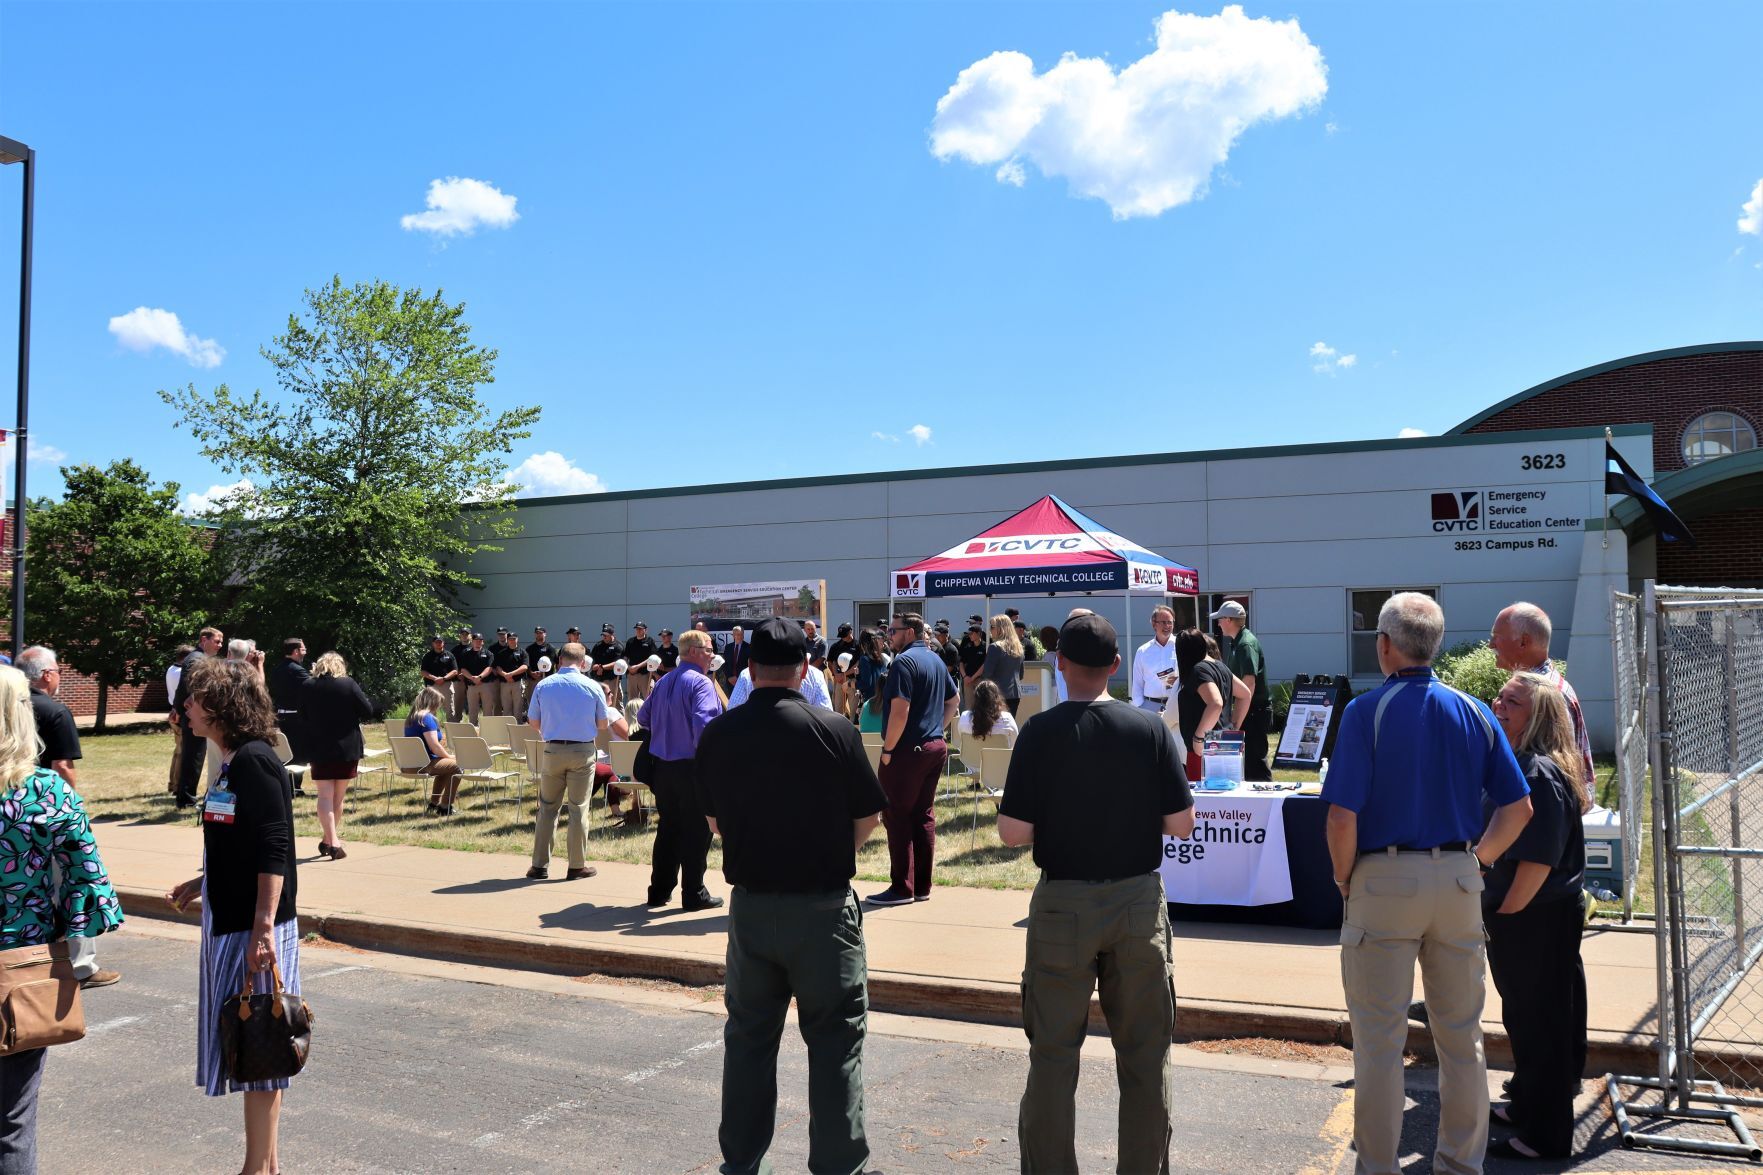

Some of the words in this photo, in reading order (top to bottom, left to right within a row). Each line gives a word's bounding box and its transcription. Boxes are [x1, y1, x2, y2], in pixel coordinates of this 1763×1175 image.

[1521, 453, 1566, 470] 3623
[1488, 490, 1546, 501] Emergency
[1488, 505, 1527, 515] Service
[1432, 519, 1479, 532] CVTC
[1489, 518, 1542, 530] Education
[1544, 517, 1581, 528] Center
[1000, 537, 1082, 552] CVTC
[1454, 540, 1482, 551] 3623
[1485, 538, 1534, 551] Campus
[1537, 537, 1558, 548] Rd.
[934, 576, 982, 588] CHIPPEWA
[983, 575, 1016, 586] VALLEY
[1018, 573, 1070, 585] TECHNICAL
[1072, 571, 1115, 583] COLLEGE
[1142, 569, 1163, 584] CVTC
[896, 588, 919, 596] CVTC
[1194, 810, 1216, 820] ewa
[1219, 809, 1252, 822] Valley
[1163, 841, 1205, 864] ege
